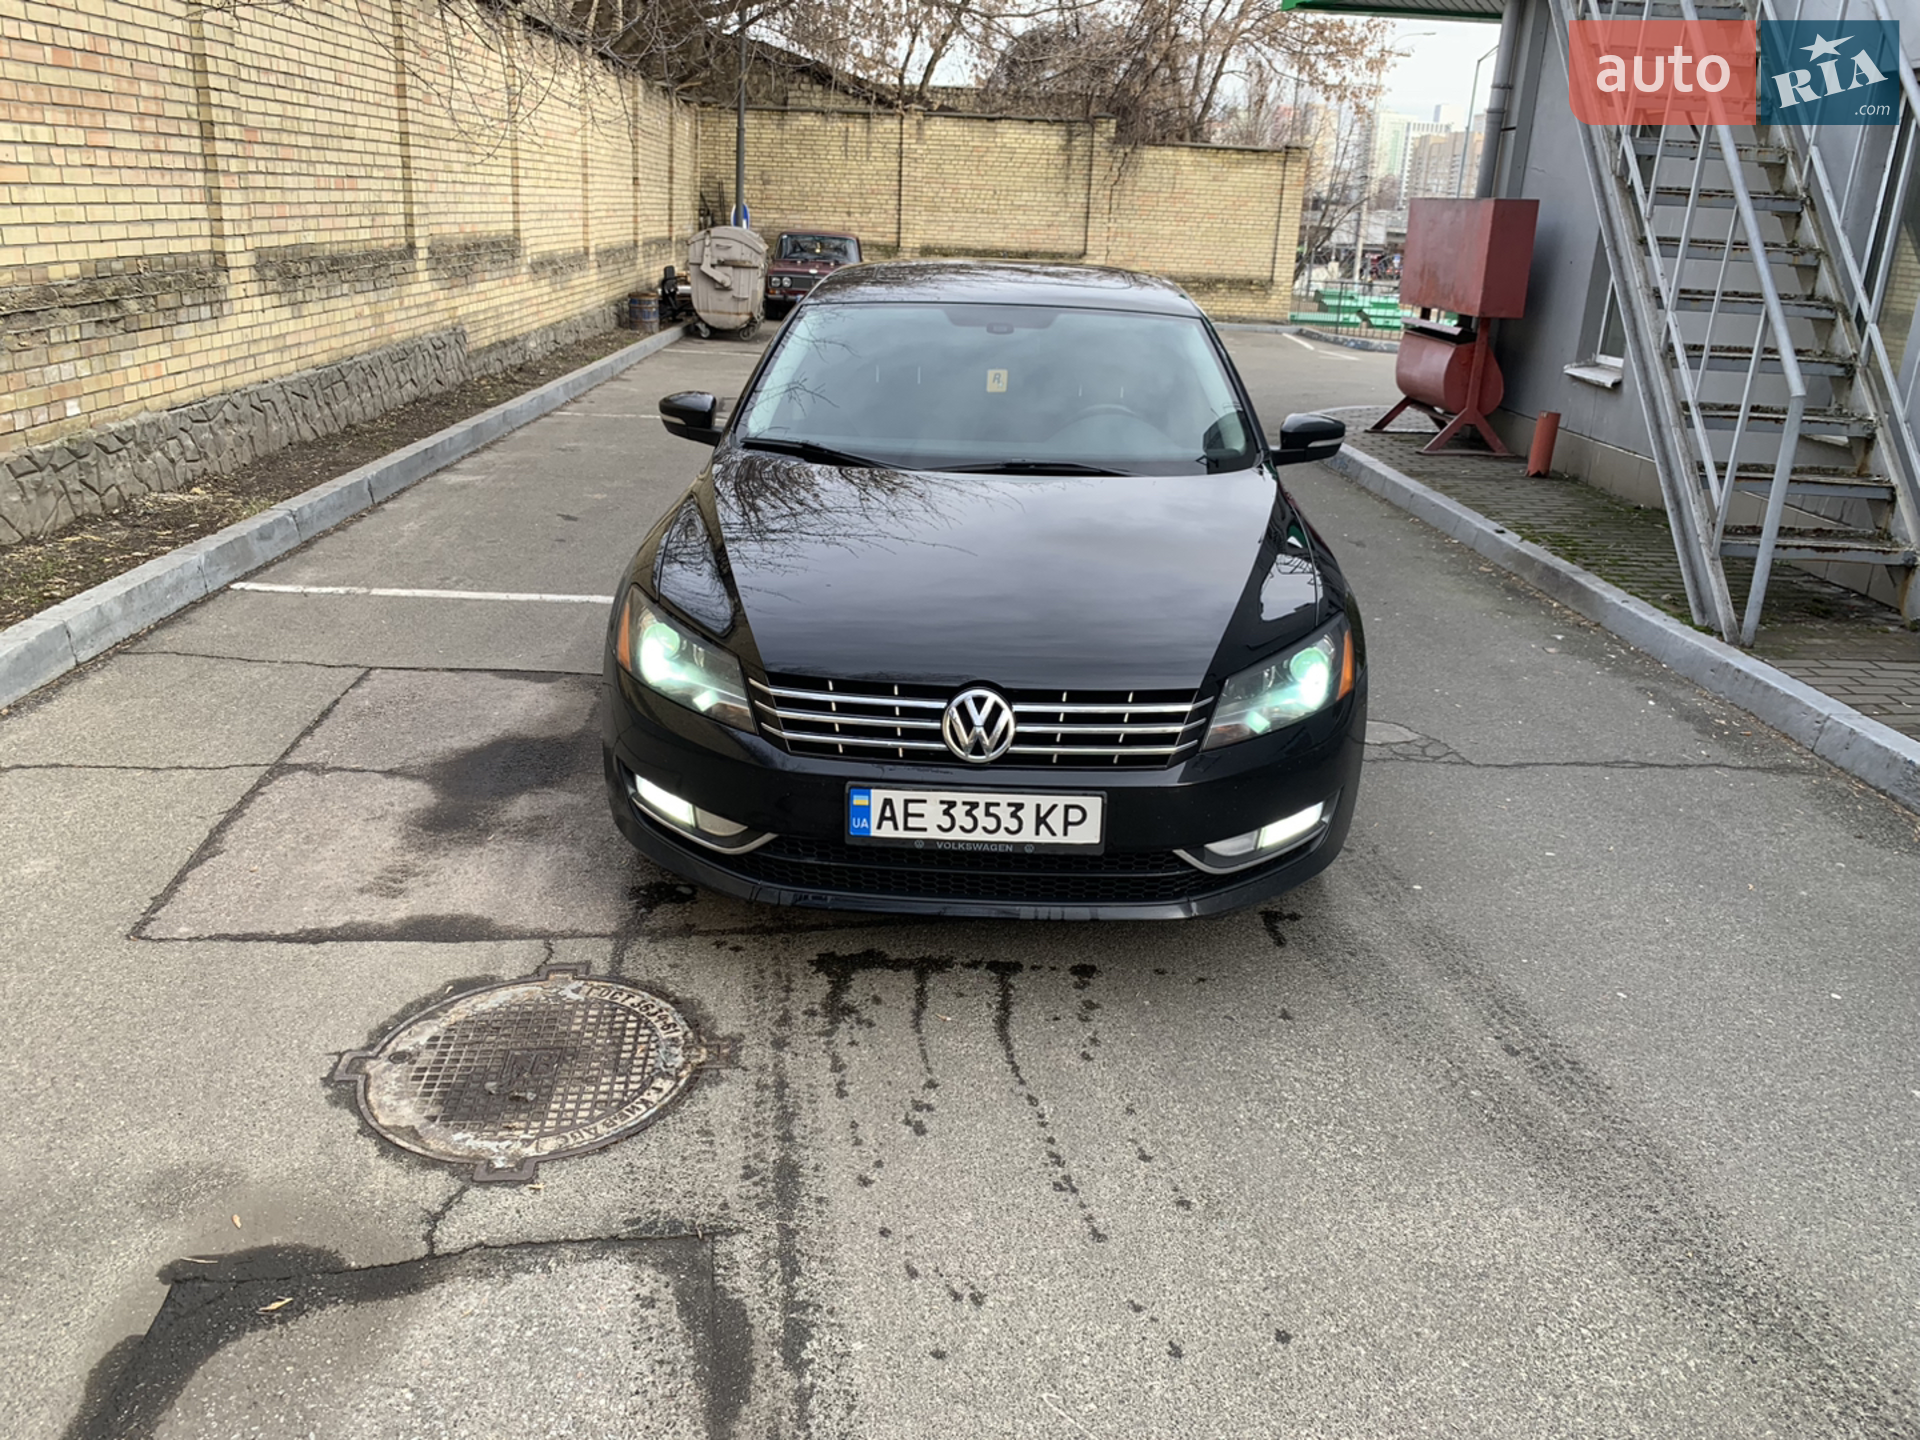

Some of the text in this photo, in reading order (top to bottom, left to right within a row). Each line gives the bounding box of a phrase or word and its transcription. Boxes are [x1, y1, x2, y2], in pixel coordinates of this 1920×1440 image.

[852, 817, 869, 829] UA
[876, 797, 1088, 837] AE 3353 KP
[936, 841, 1013, 853] VOLKSWAGEN
